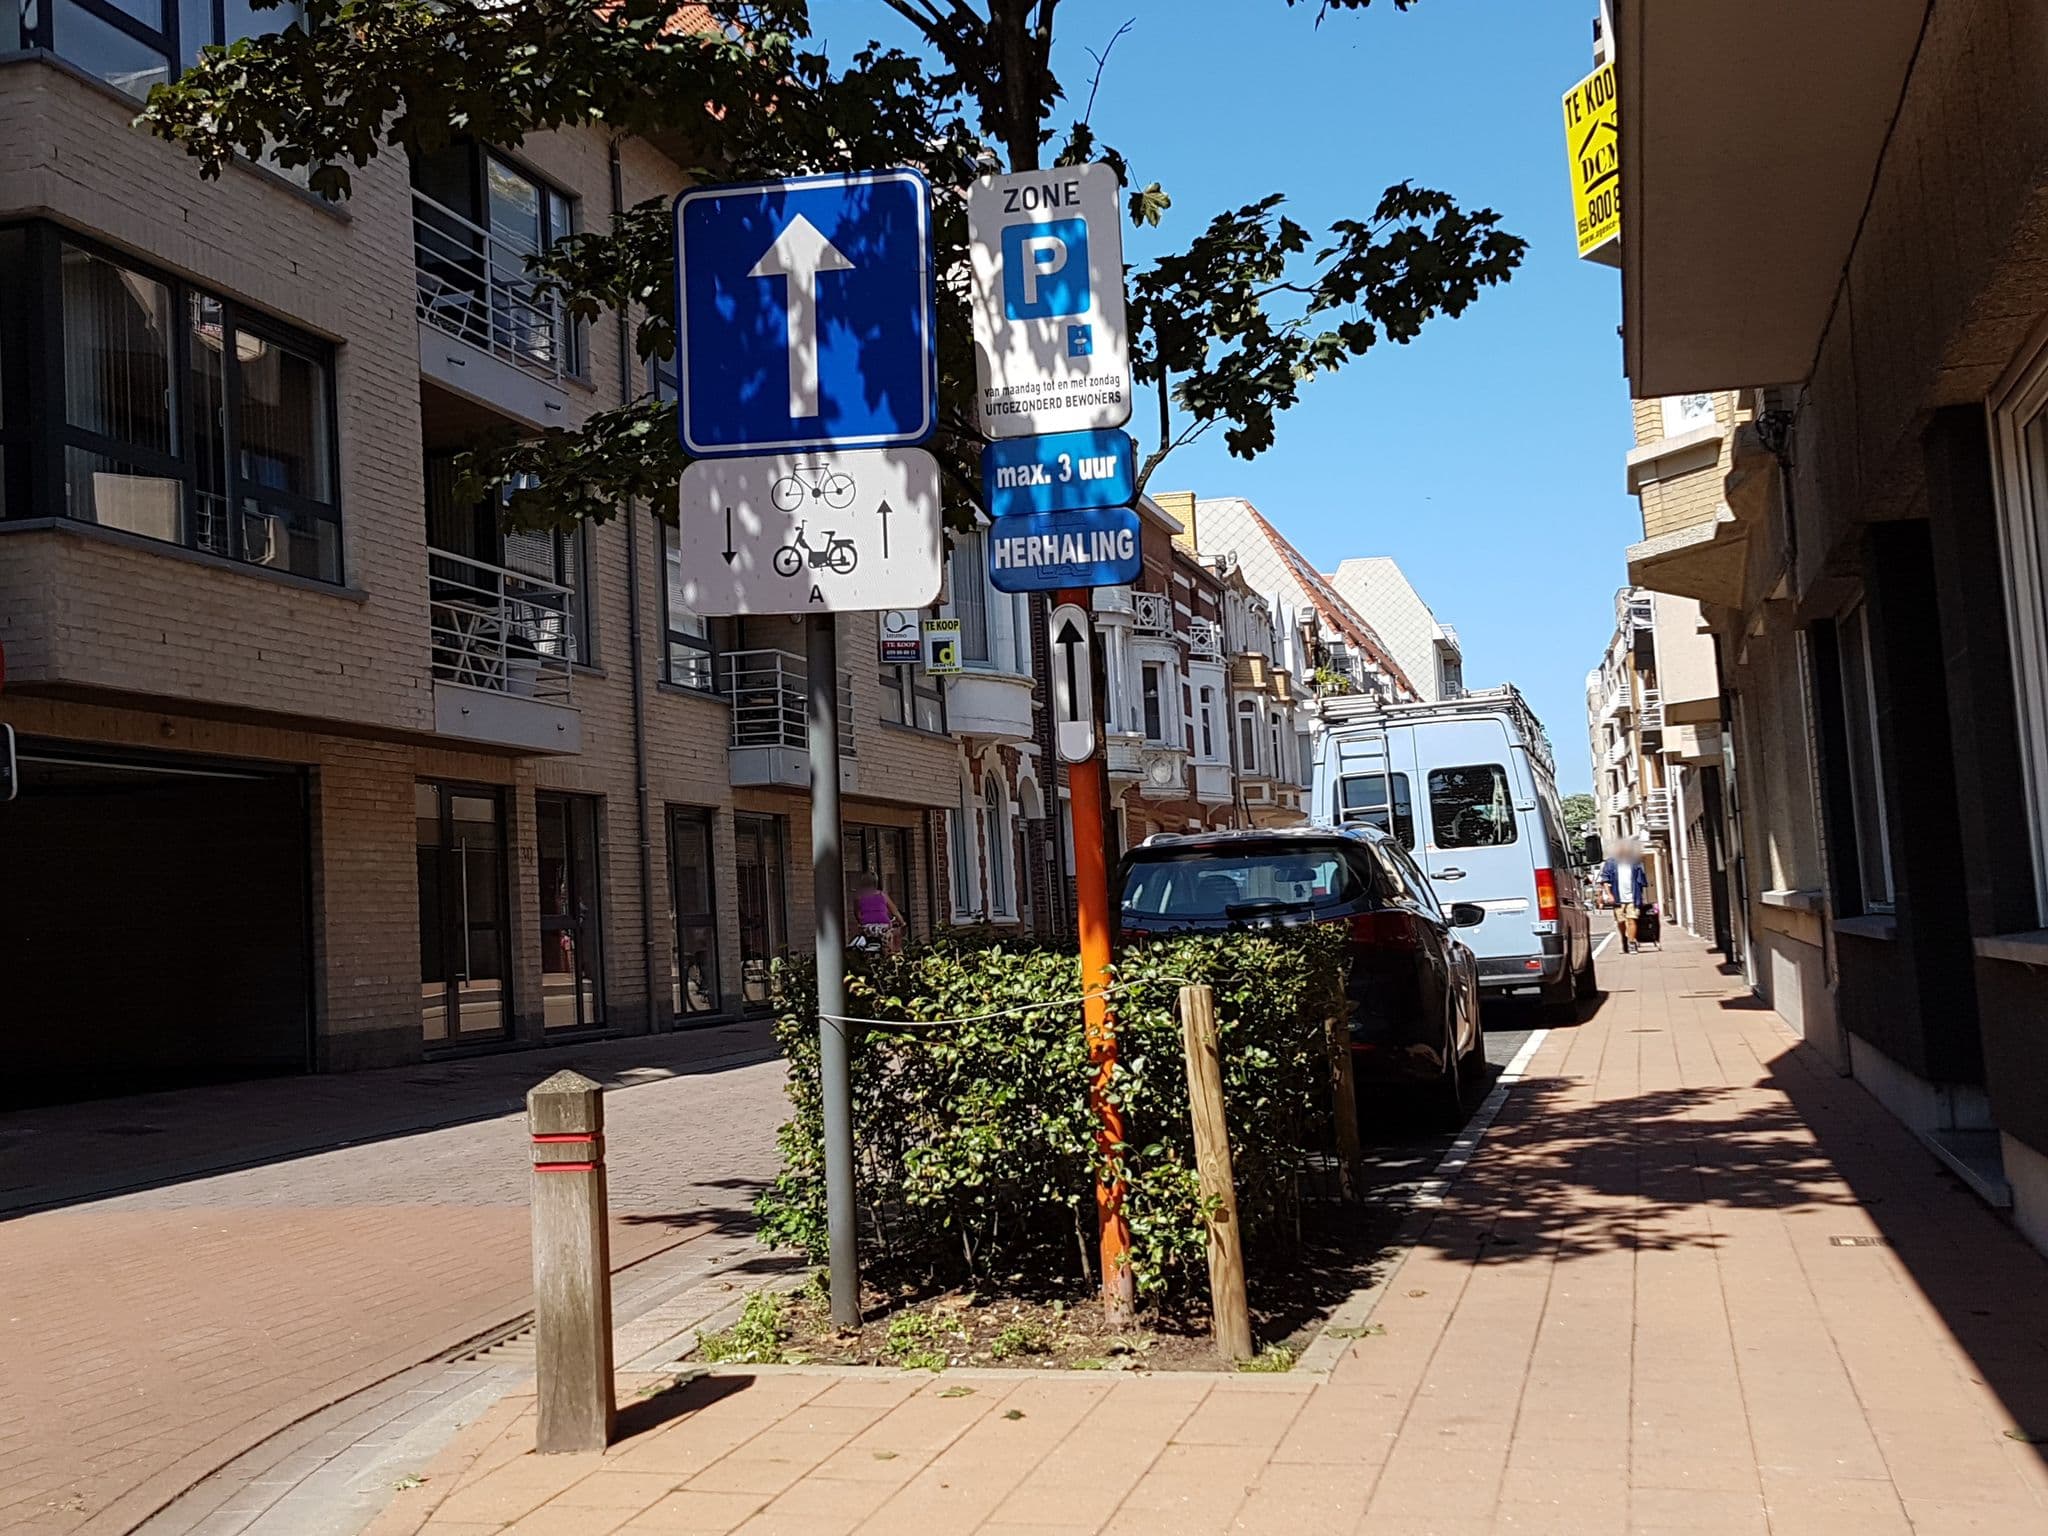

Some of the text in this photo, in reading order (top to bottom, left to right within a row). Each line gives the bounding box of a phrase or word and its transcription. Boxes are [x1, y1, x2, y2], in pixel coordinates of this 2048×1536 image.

[1565, 67, 1615, 129] TE KOO
[1003, 181, 1081, 213] ZONE
[1588, 189, 1612, 228] 800
[1022, 236, 1067, 305] P
[984, 374, 1120, 398] van maandag tot en met zondag
[986, 391, 1122, 417] UITGEZONDERD BEWONERS
[997, 453, 1117, 488] max. 3 uur
[995, 529, 1133, 569] HERHALING
[808, 585, 825, 604] A
[925, 620, 959, 632] TE KOOP
